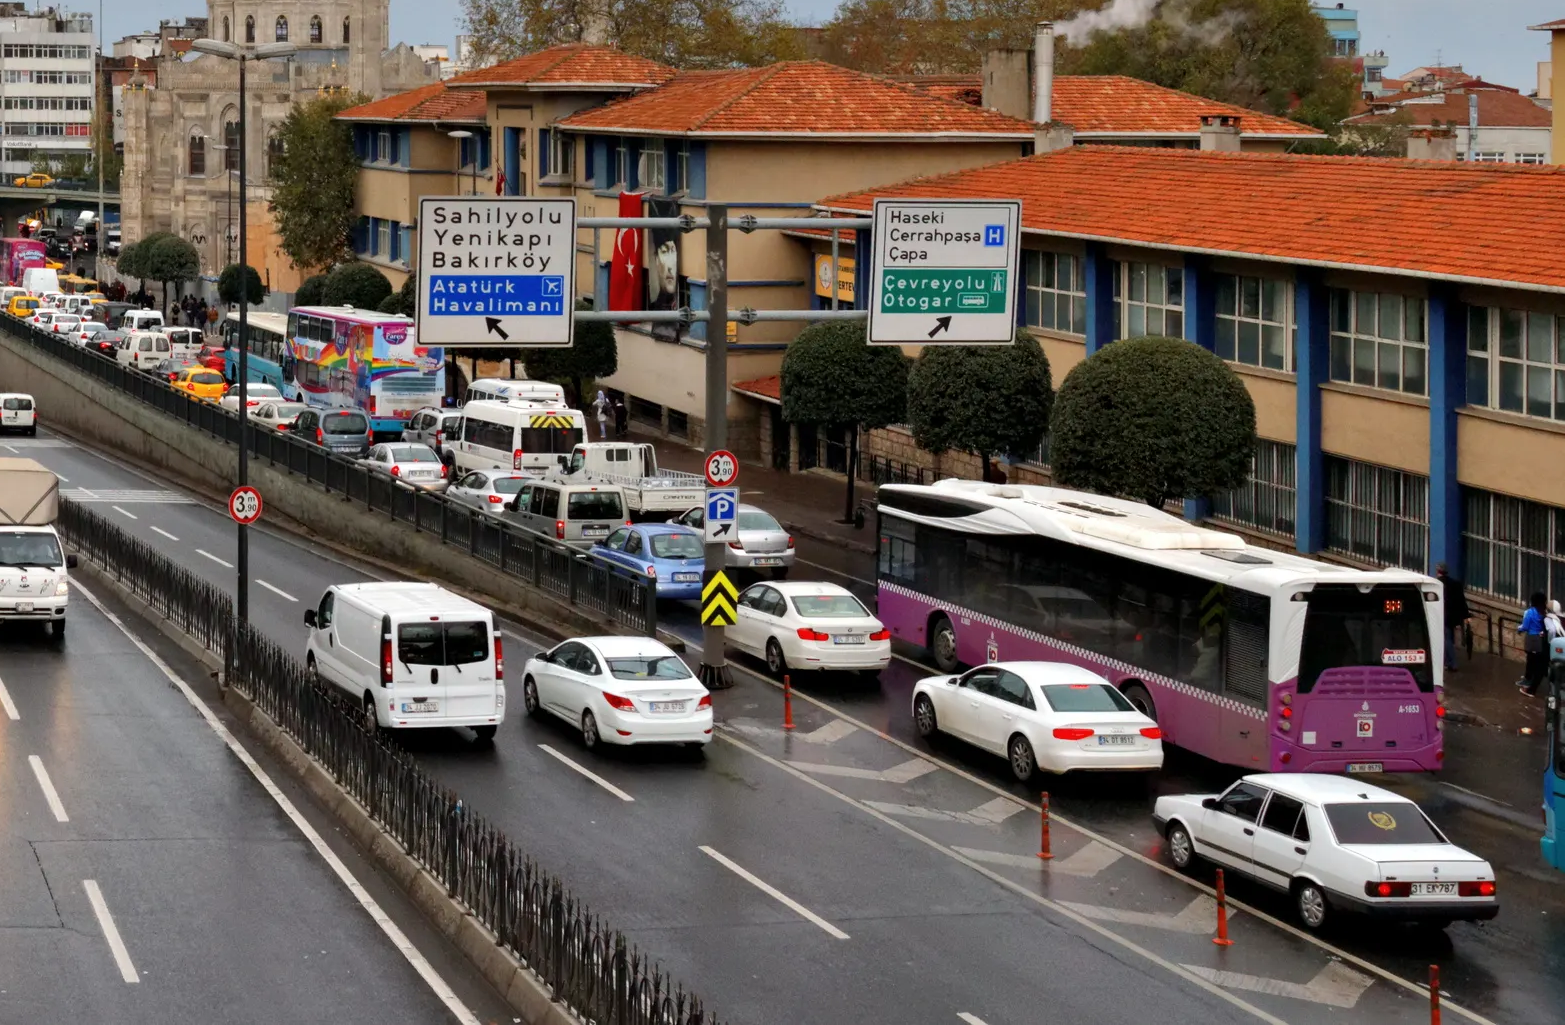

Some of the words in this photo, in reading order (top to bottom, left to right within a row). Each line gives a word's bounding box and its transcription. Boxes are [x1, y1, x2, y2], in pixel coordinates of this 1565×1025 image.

[433, 207, 561, 228] Sahilyolu
[890, 211, 944, 224] Haseki
[434, 229, 551, 250] Yenikapı
[890, 228, 981, 245] Cerrahpaşa
[432, 251, 551, 272] Bakırköy
[889, 246, 928, 263] Çapa
[433, 279, 515, 293] Atatürk
[884, 275, 985, 292] Çevreyolu
[433, 298, 559, 311] Havalimanı
[884, 293, 952, 310] Otogar
[1412, 884, 1422, 893] 31
[1427, 884, 1437, 893] EK
[1439, 884, 1455, 893] 787
